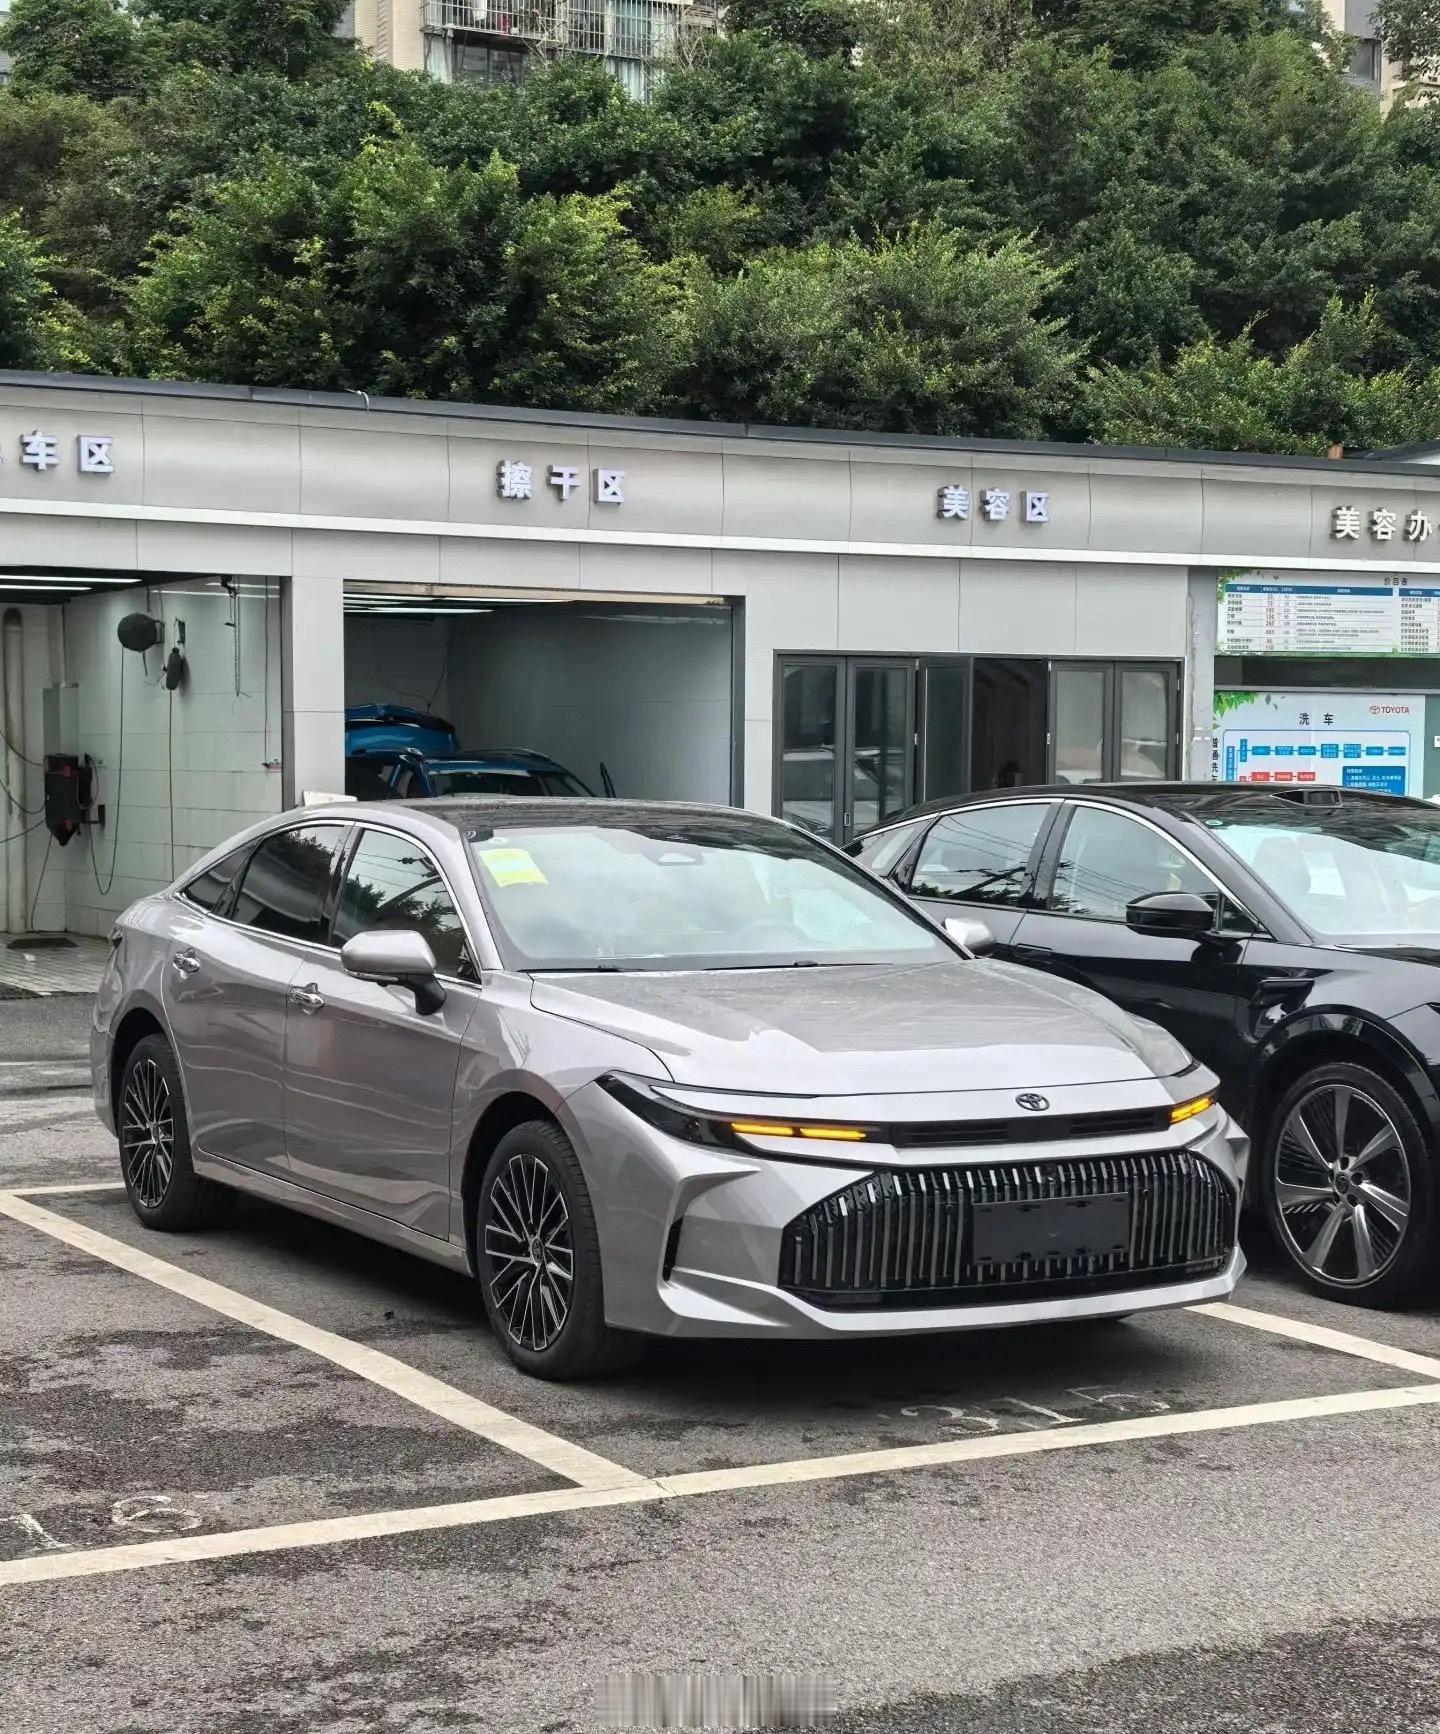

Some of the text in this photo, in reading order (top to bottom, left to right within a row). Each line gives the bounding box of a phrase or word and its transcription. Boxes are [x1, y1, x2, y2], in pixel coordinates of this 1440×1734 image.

[0, 430, 115, 475] 车区
[498, 459, 626, 505] 擦干区
[937, 484, 1051, 525] 美容区
[1331, 506, 1440, 541] 美容办
[1299, 712, 1334, 726] 洗车
[1381, 706, 1410, 714] TOYOTA
